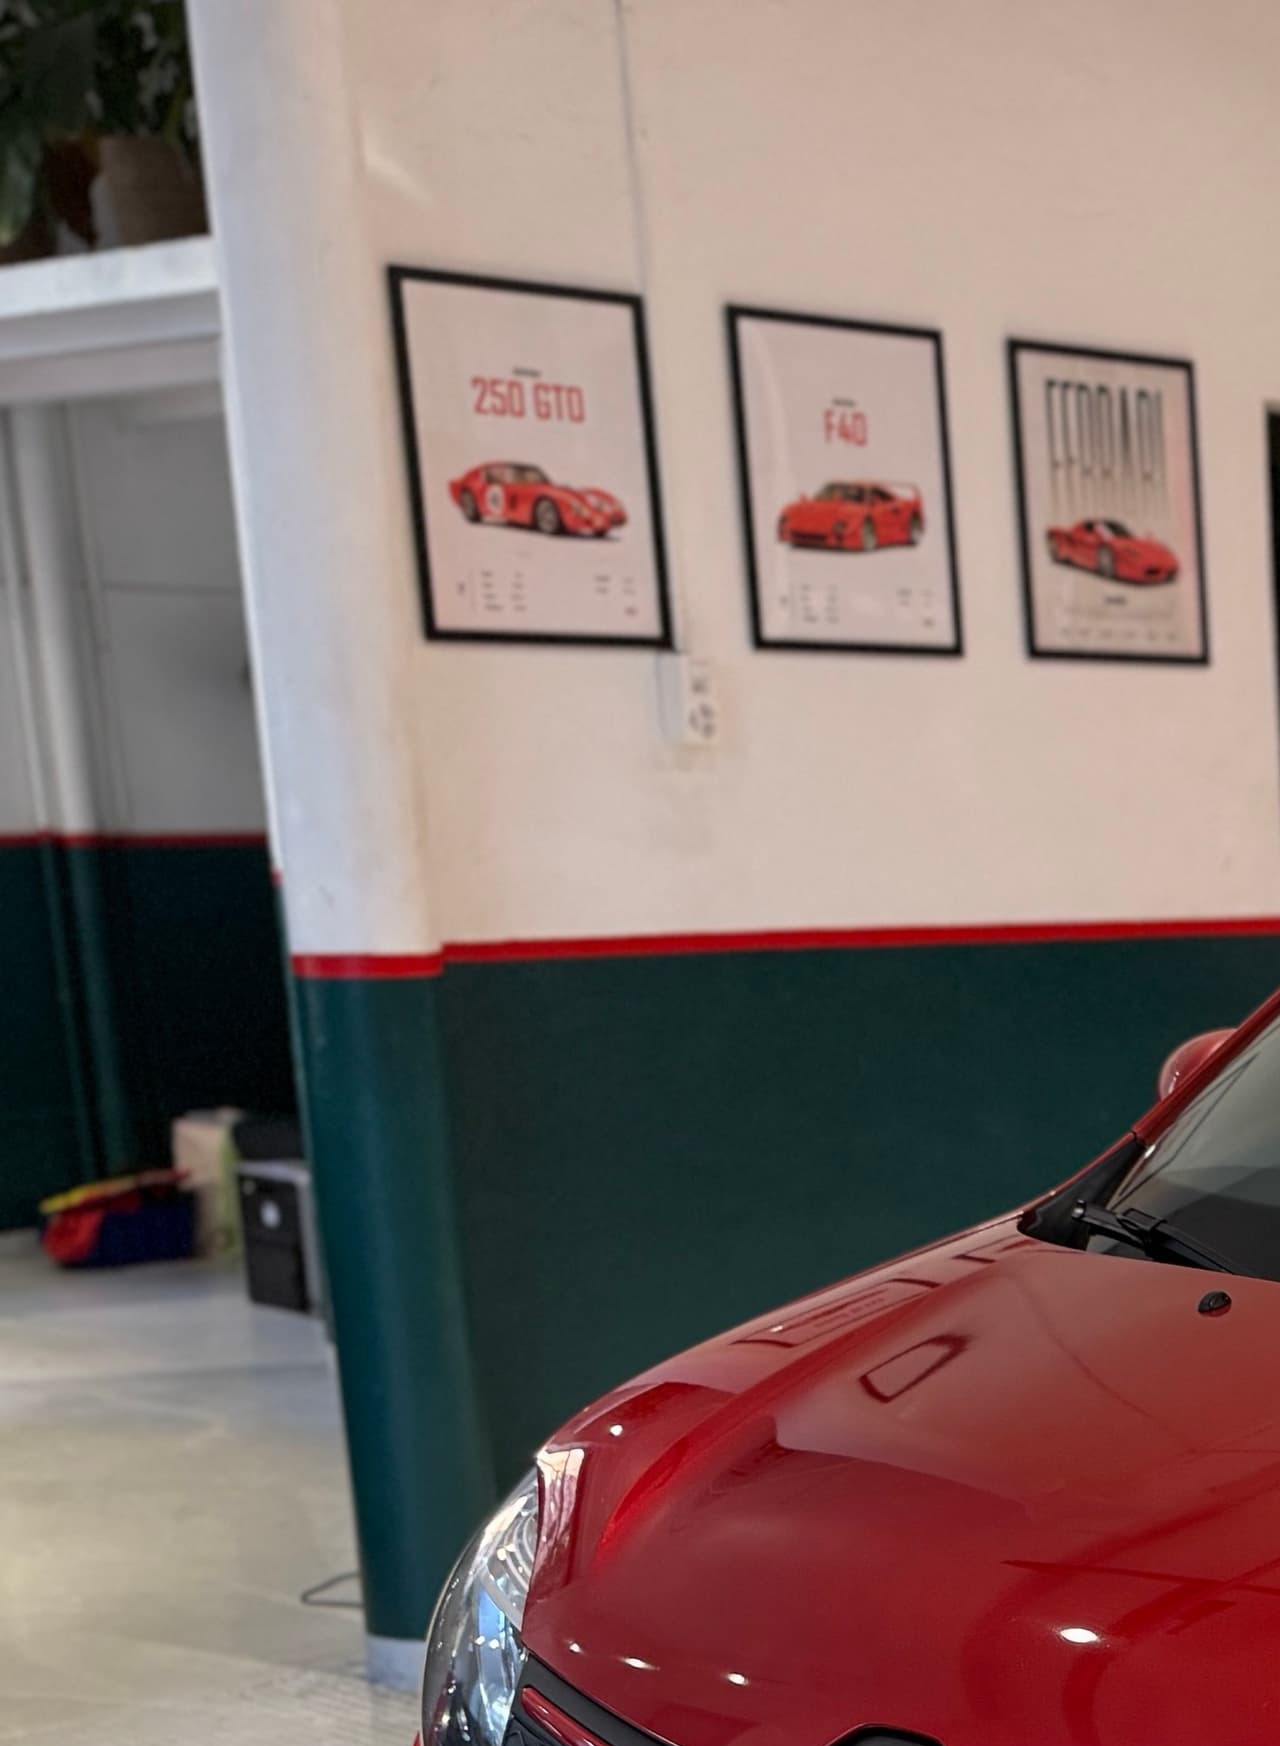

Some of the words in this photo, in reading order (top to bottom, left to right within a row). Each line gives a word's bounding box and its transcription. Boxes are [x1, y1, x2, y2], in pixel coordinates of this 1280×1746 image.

[470, 376, 526, 419] 250
[532, 383, 586, 425] GTO
[823, 407, 868, 447] F40
